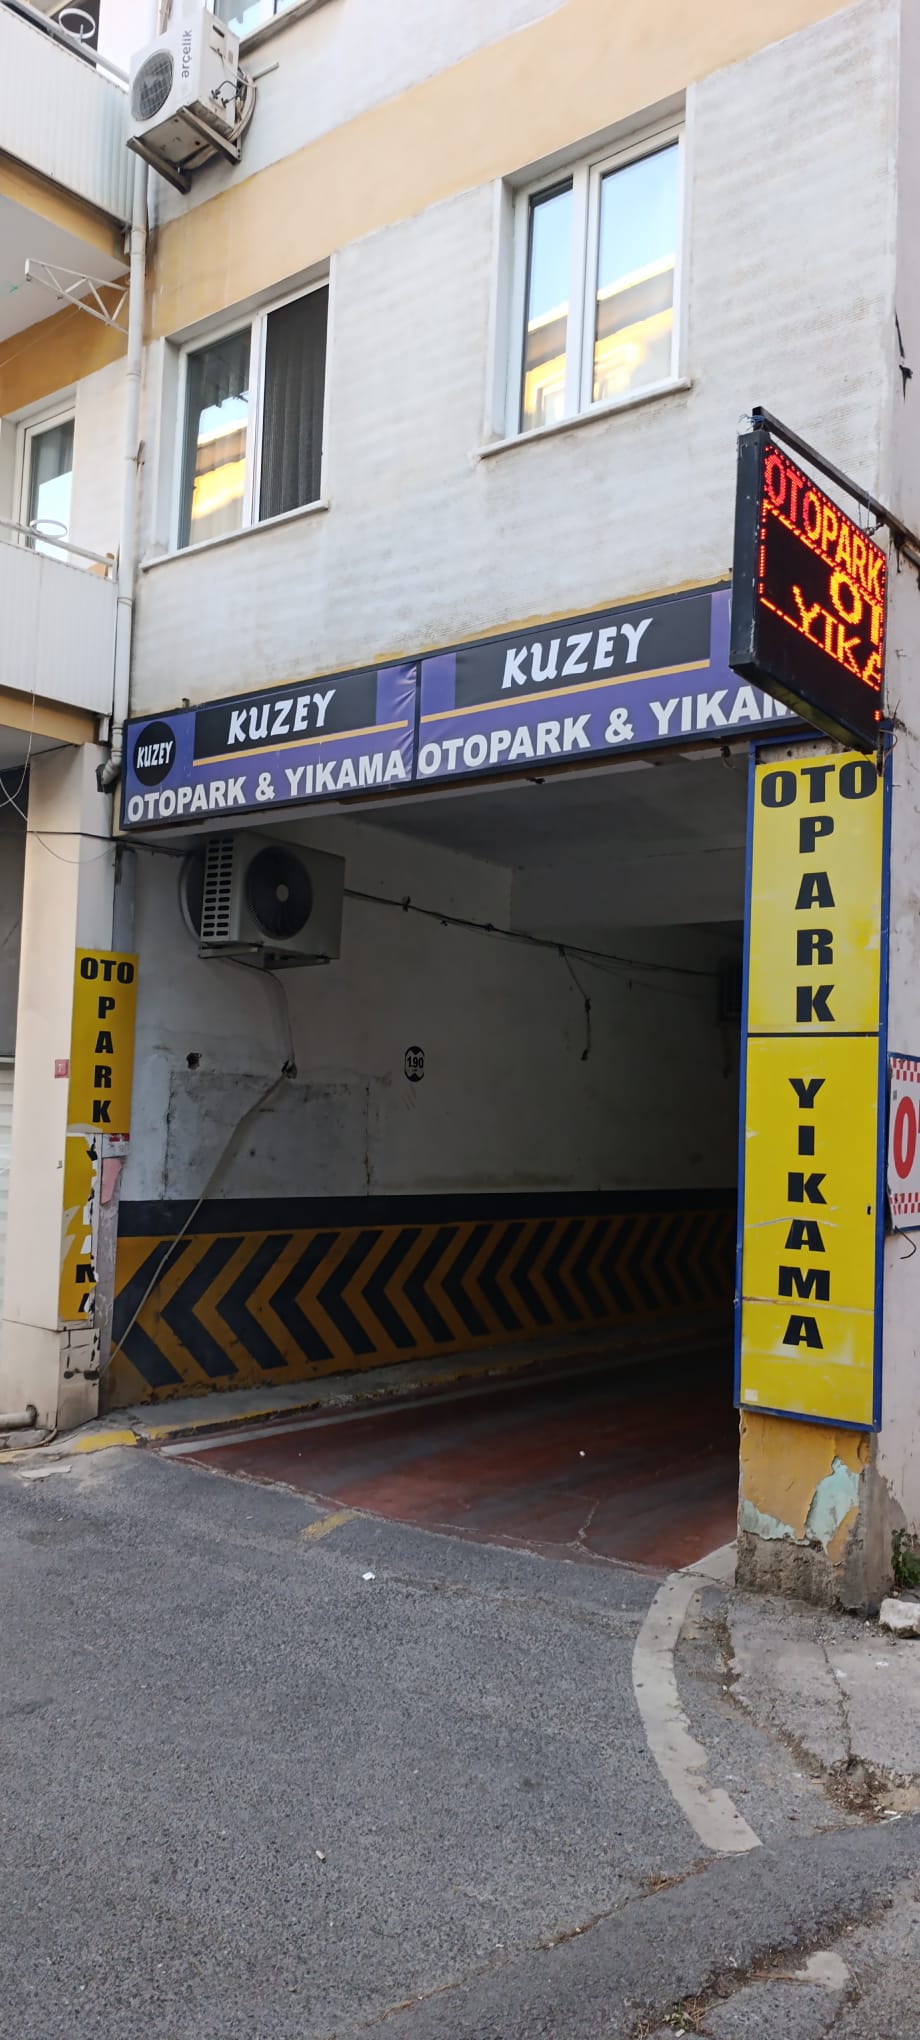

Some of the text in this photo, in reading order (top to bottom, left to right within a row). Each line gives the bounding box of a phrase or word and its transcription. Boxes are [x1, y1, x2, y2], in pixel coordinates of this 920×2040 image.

[181, 29, 192, 79] arçelik
[764, 453, 883, 600] OTOPARK
[501, 617, 654, 689] KUZEY
[226, 689, 336, 745] KUZEY
[417, 714, 591, 774] OTOPARK
[604, 707, 635, 744] &
[127, 749, 407, 821] OTOPARK & YIKAMA
[136, 740, 174, 770] KUZEY
[760, 760, 878, 809] OTO
[794, 815, 836, 1023] PARK
[80, 957, 135, 985] OTO
[92, 996, 115, 1124] PARK
[777, 1077, 831, 1351] YIKAMA
